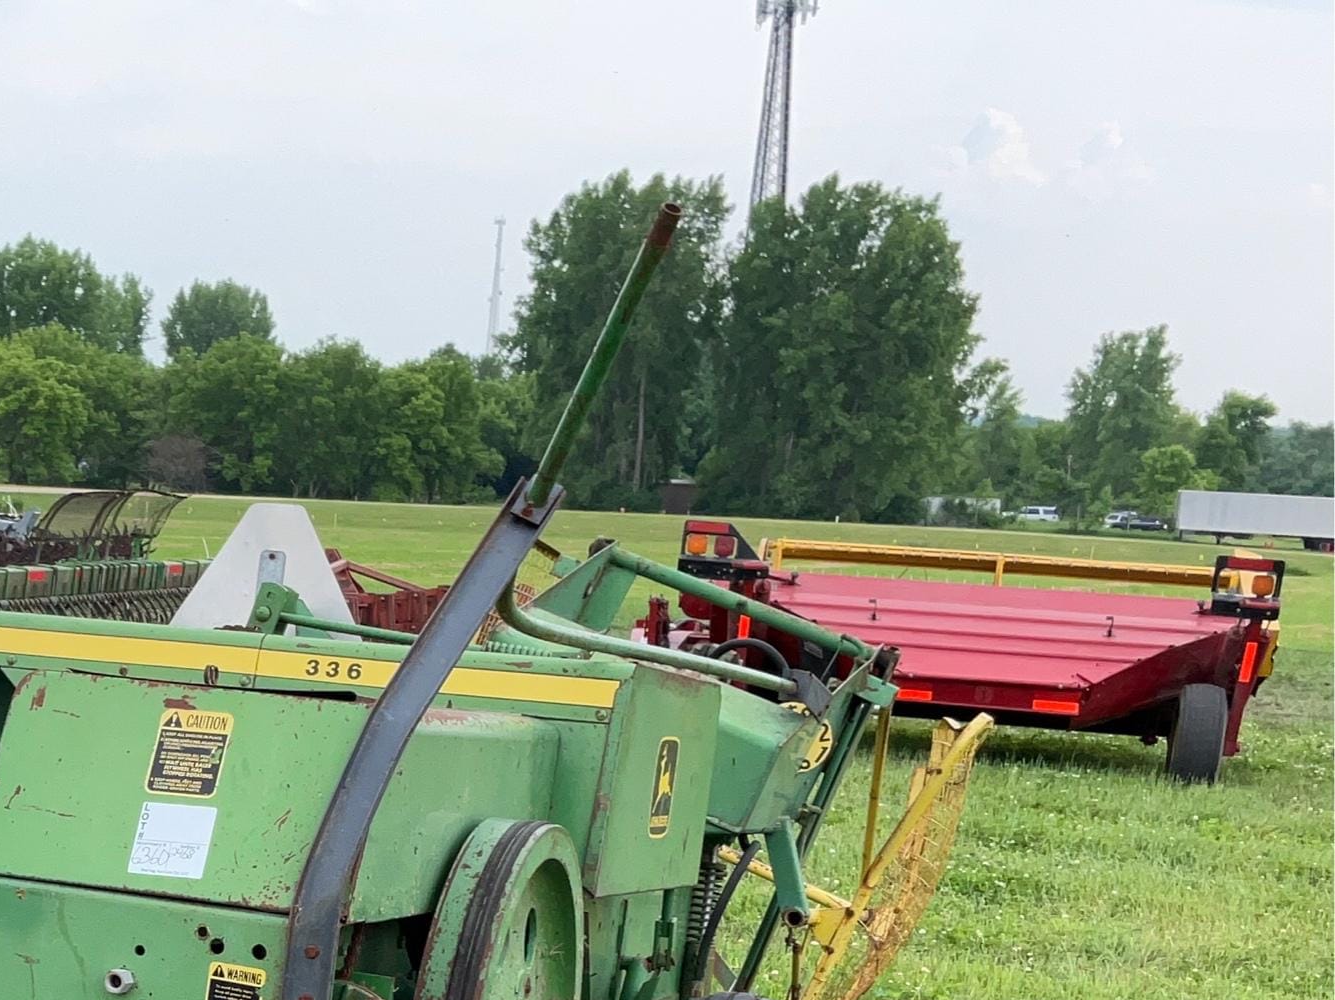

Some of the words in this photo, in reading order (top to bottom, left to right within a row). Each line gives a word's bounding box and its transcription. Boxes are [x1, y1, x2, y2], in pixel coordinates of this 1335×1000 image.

[305, 659, 363, 680] 336
[186, 714, 228, 731] CAUTION
[819, 723, 831, 743] 2
[227, 968, 262, 985] WARNING
